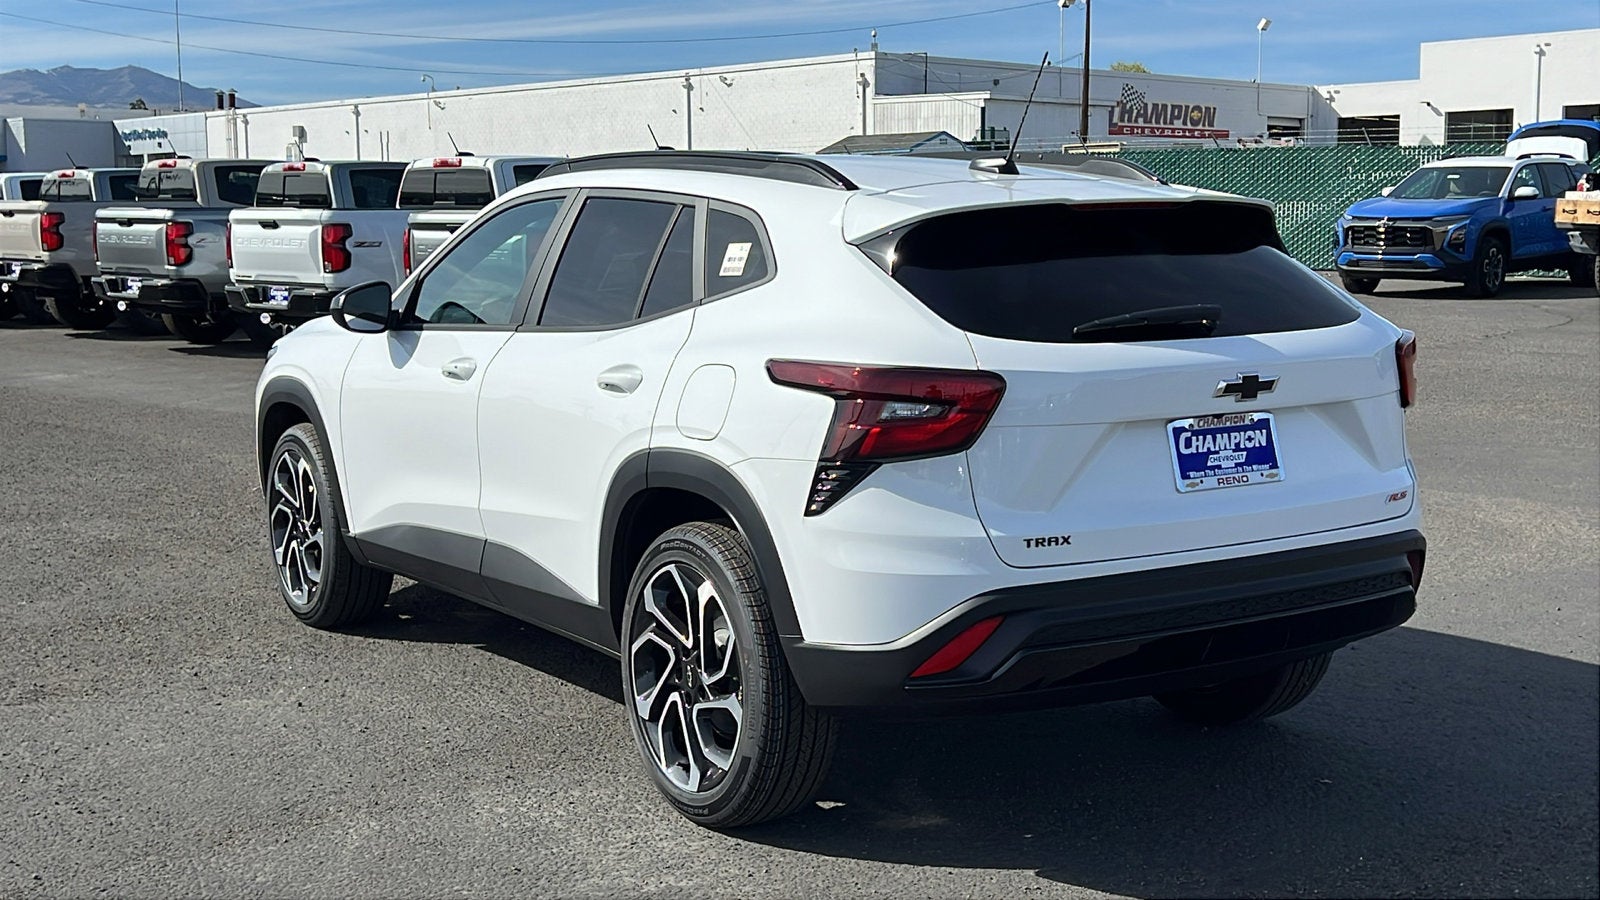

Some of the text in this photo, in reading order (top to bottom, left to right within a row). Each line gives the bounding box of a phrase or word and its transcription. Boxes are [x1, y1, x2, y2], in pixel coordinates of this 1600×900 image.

[1123, 127, 1213, 137] CHEVROLET
[235, 237, 307, 248] CHEVROLET
[1196, 414, 1246, 428] CHAMPION
[1178, 429, 1267, 455] CHAMPION
[1209, 452, 1245, 464] CHEVROLET
[1217, 475, 1249, 486] RENO
[1023, 535, 1071, 549] TRAX
